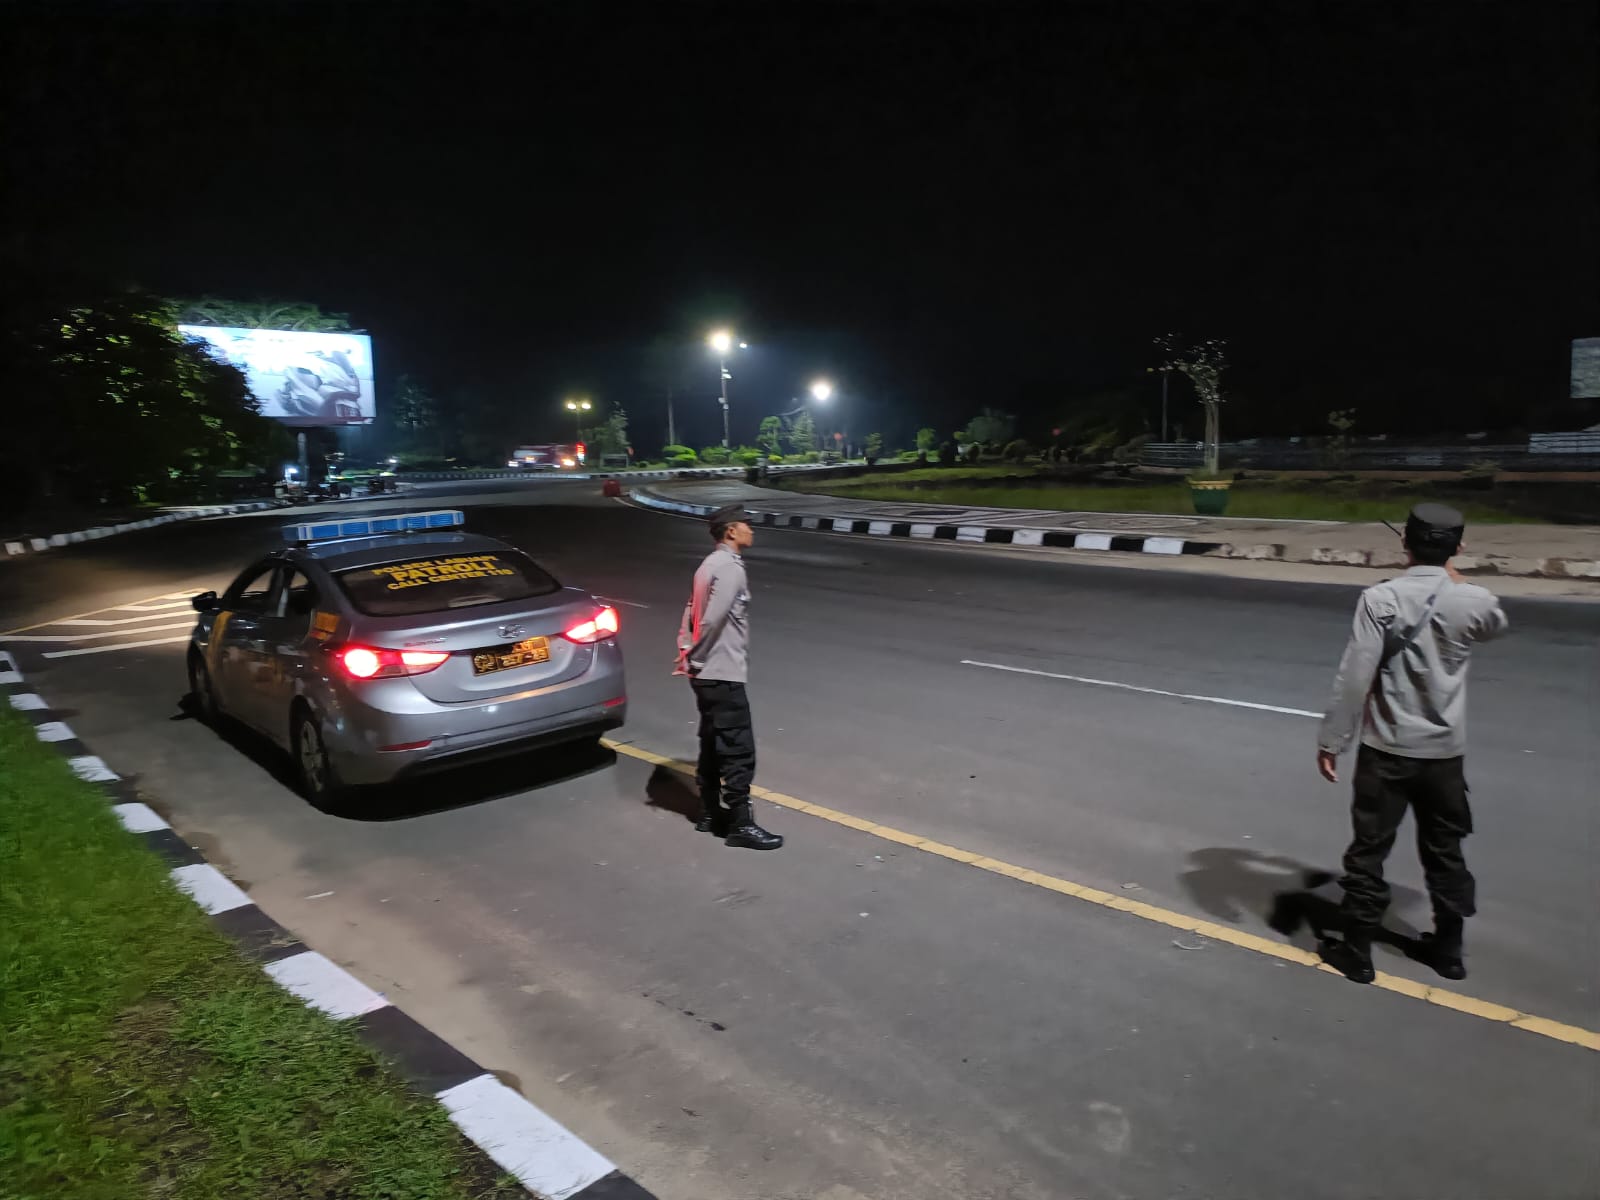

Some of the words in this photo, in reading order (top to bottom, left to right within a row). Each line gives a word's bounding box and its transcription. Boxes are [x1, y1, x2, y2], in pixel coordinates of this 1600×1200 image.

[371, 562, 433, 575] POLSEK
[390, 562, 496, 581] PATROLI
[387, 579, 429, 589] CALL
[428, 571, 489, 582] CENTER
